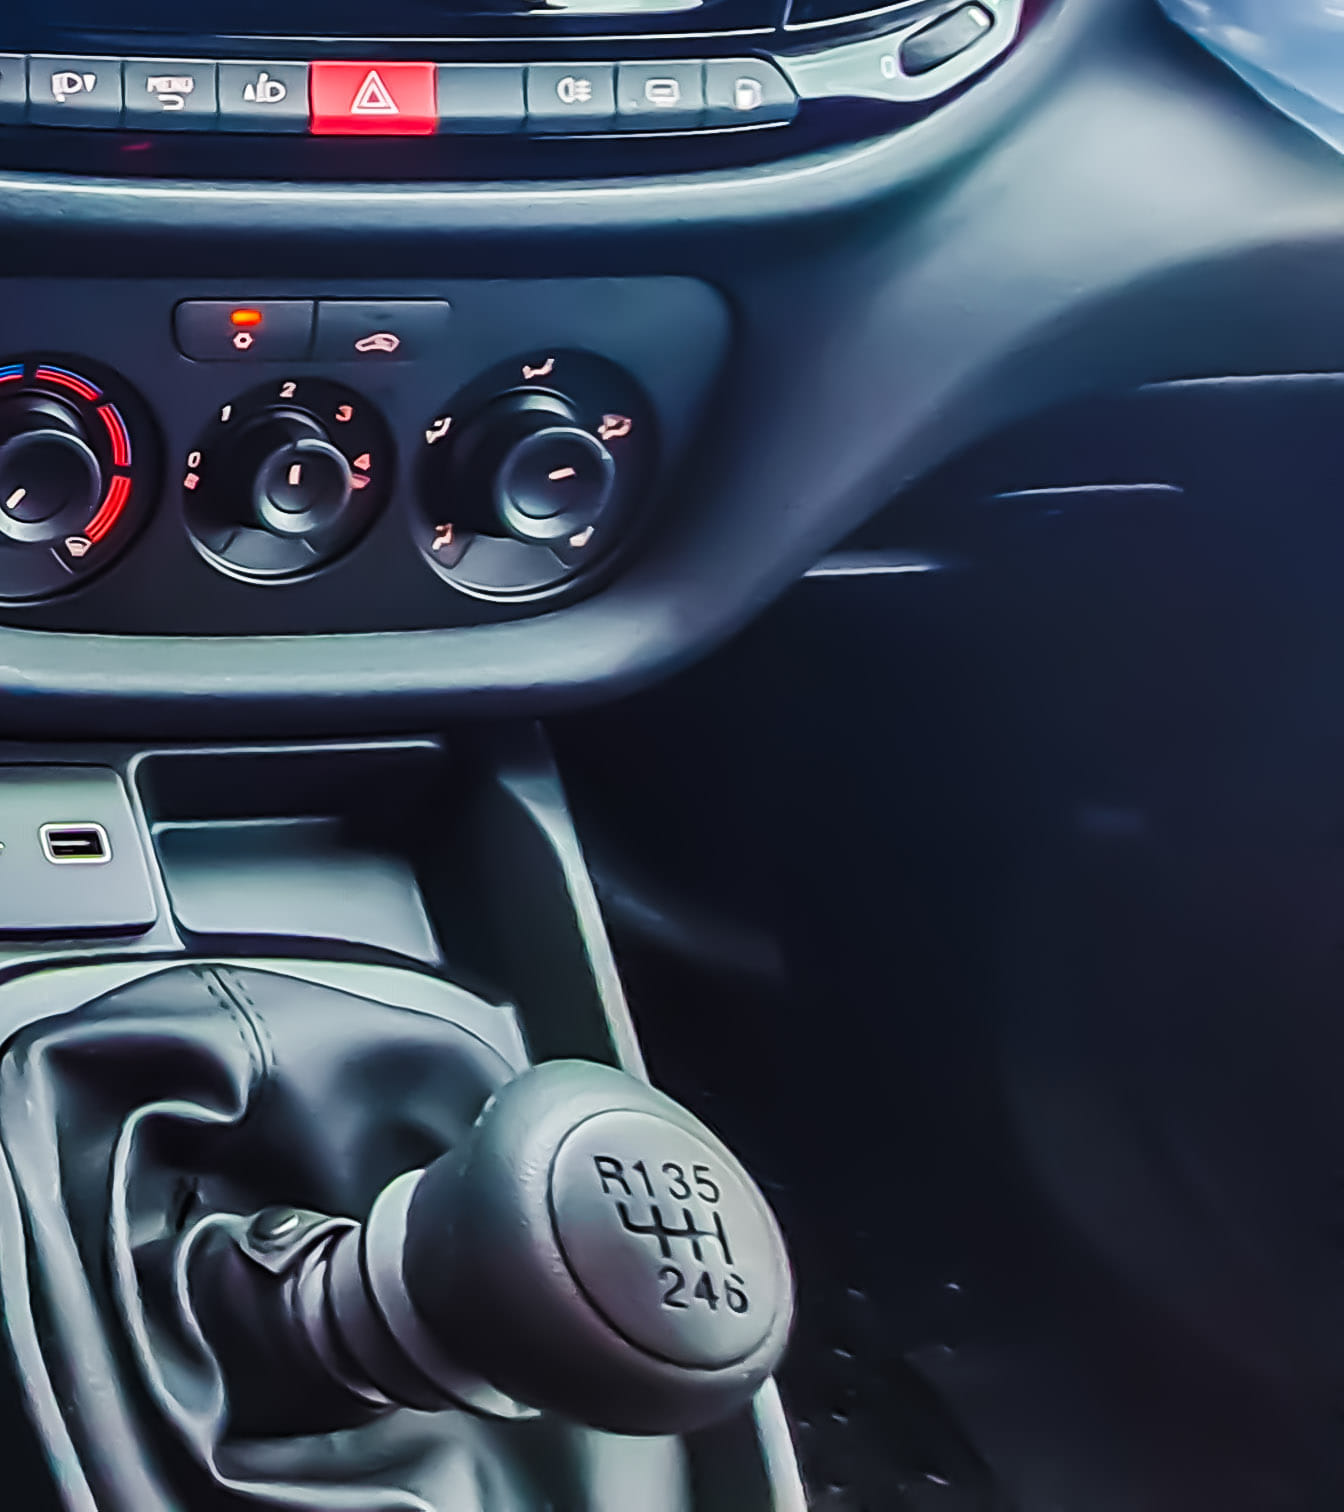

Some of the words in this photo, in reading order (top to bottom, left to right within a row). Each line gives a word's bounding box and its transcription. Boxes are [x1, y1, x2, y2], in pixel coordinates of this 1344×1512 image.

[279, 381, 297, 399] 2
[220, 404, 233, 423] 1
[187, 451, 202, 469] 0
